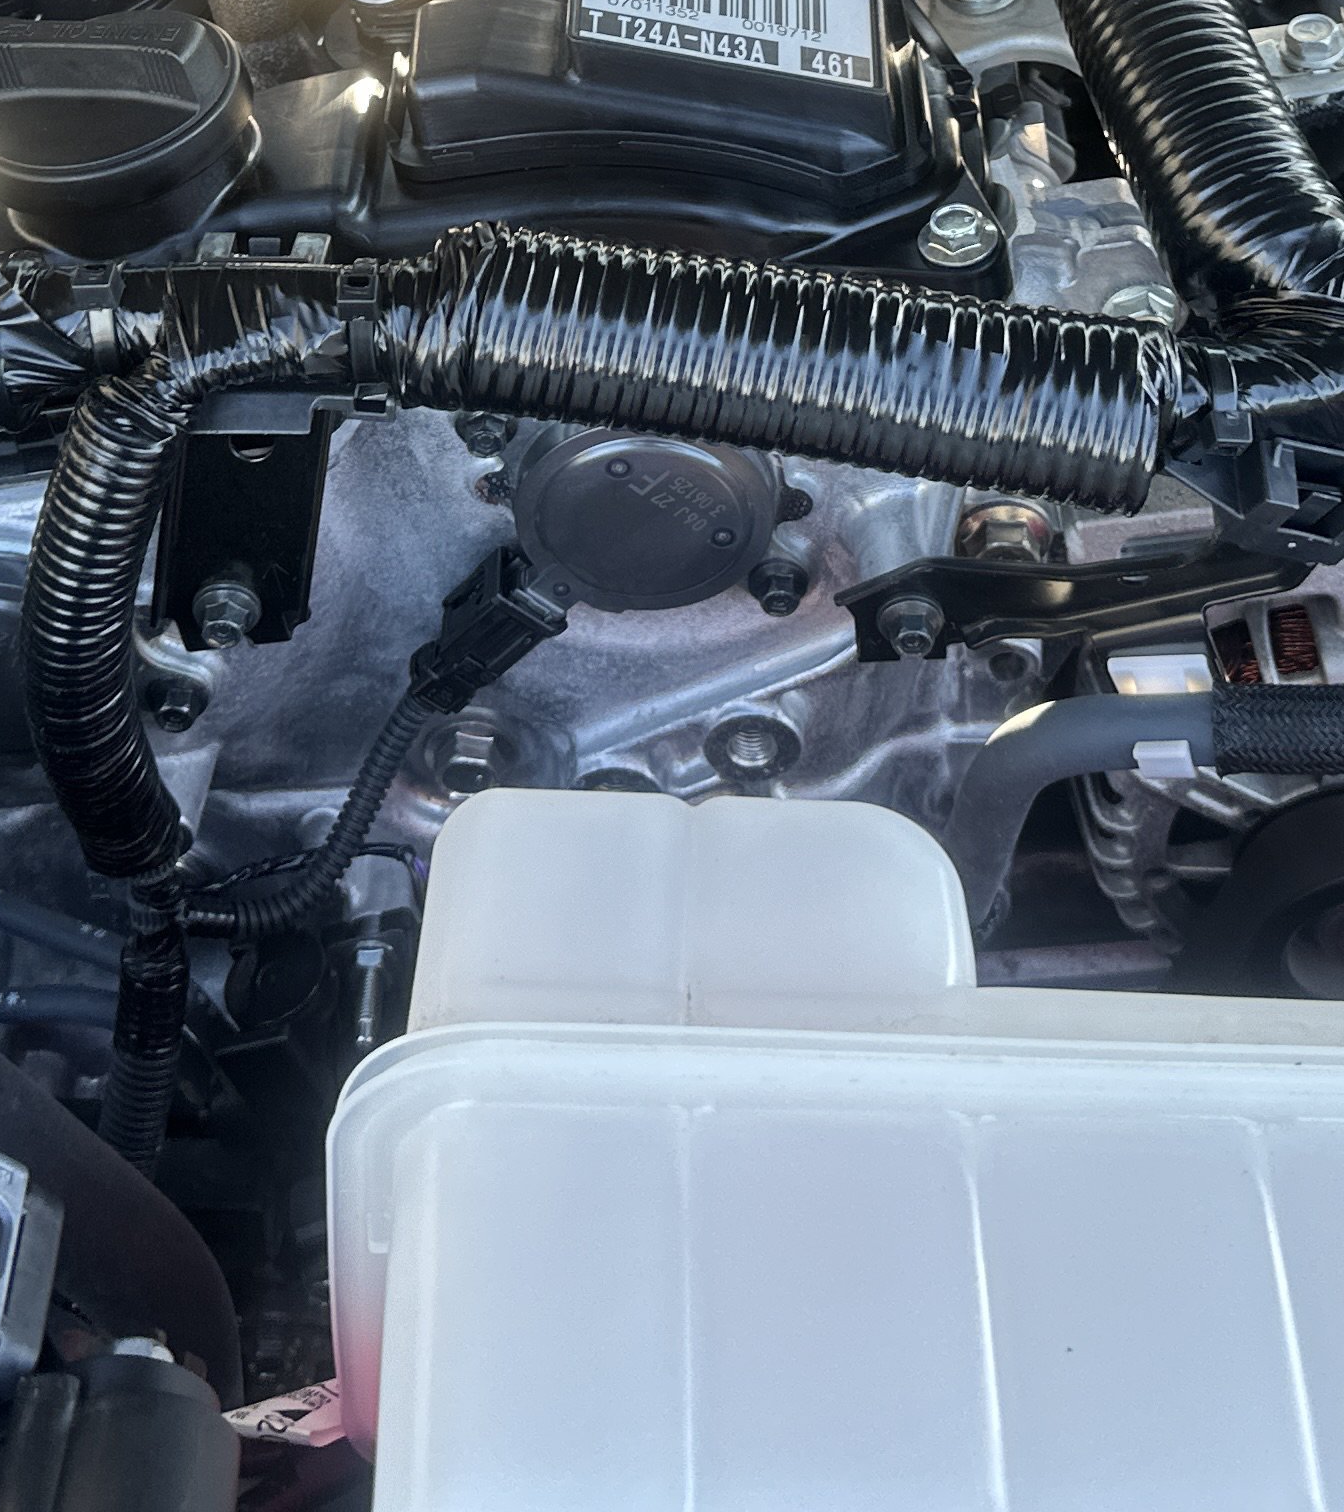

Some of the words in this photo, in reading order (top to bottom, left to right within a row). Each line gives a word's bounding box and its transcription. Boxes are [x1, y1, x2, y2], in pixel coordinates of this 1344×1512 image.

[742, 18, 822, 43] 0019712
[588, 10, 603, 34] T
[617, 15, 766, 65] T24A-N43A
[811, 50, 855, 80] 461
[628, 469, 671, 497] F
[668, 476, 713, 510] 06125
[650, 494, 676, 510] 27
